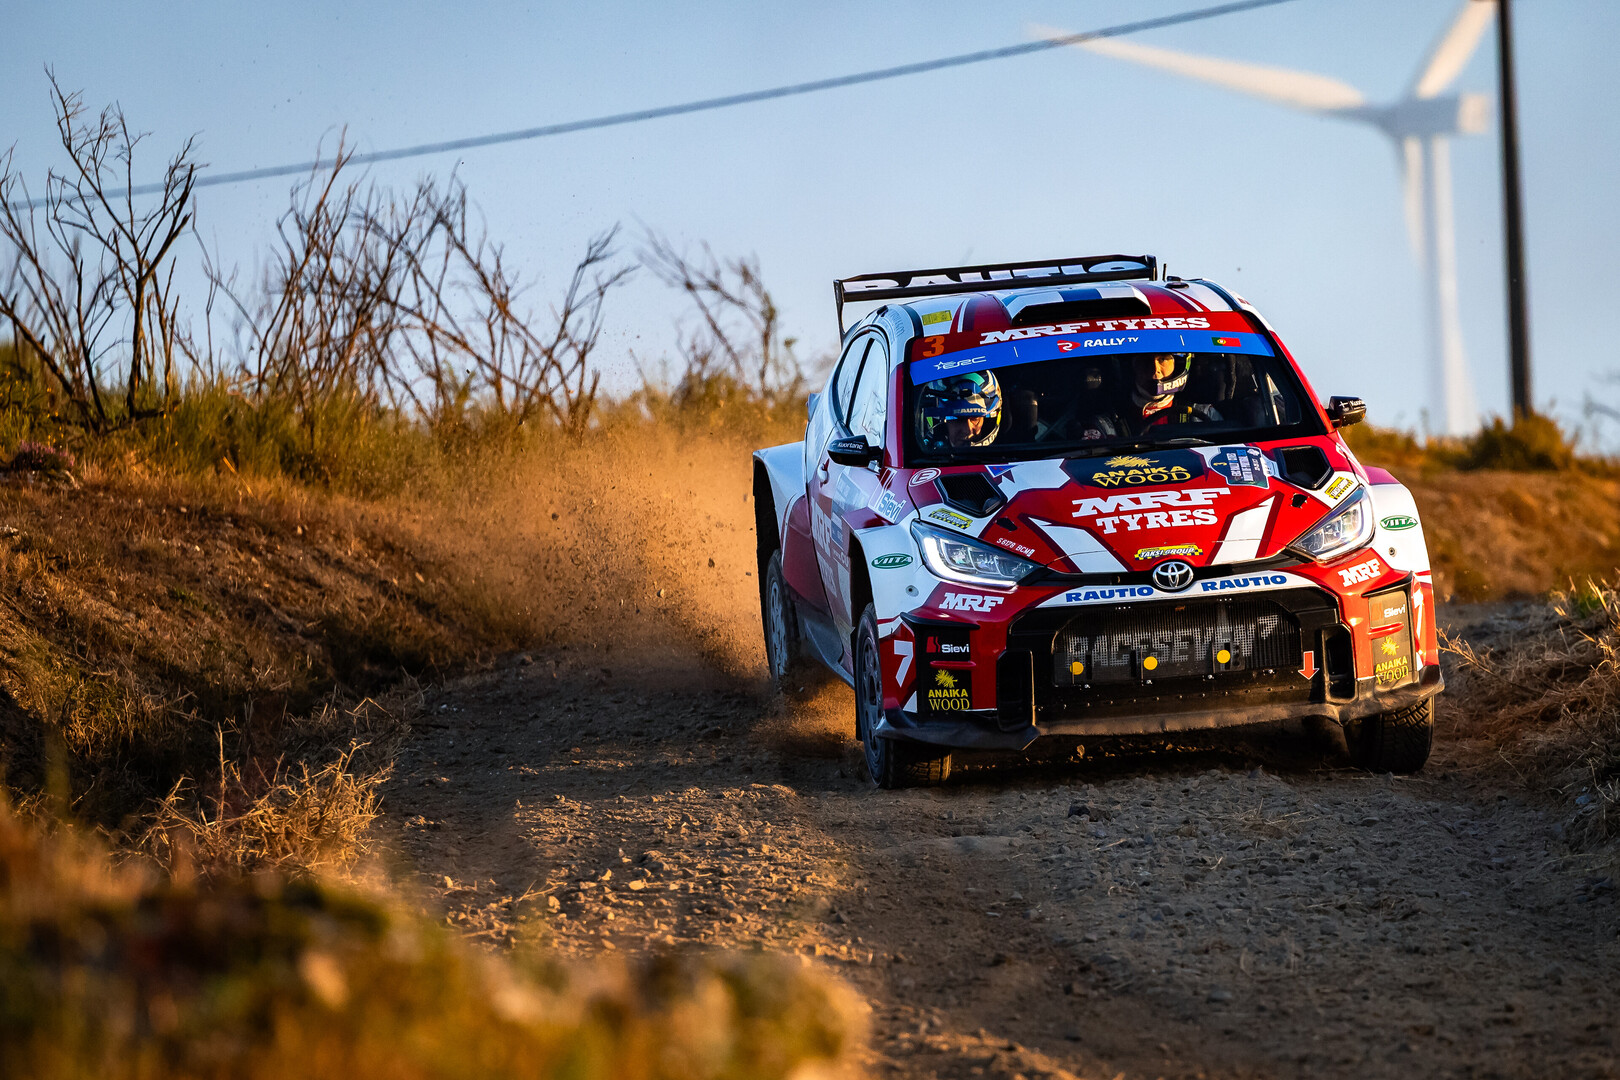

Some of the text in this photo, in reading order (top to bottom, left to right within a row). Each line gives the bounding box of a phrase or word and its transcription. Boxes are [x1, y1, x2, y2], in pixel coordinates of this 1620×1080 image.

[980, 317, 1211, 345] MRF TYRES
[922, 336, 945, 358] 3
[1091, 465, 1188, 480] ANAIKA
[1095, 470, 1192, 488] WOOD
[1072, 487, 1231, 518] MRF
[1096, 508, 1219, 535] TYRES
[1380, 517, 1418, 530] VIITA
[873, 556, 913, 567] VIITA
[1337, 557, 1381, 587] MRF
[1066, 574, 1288, 603] RAUTIO RAUTIO
[939, 592, 1005, 613] MRF
[941, 643, 970, 653] Sievi
[893, 639, 914, 688] 7
[1375, 656, 1407, 673] ANAIKA
[1376, 667, 1409, 685] WOOD
[928, 688, 968, 698] ANAIKA
[929, 698, 970, 711] WOOD
